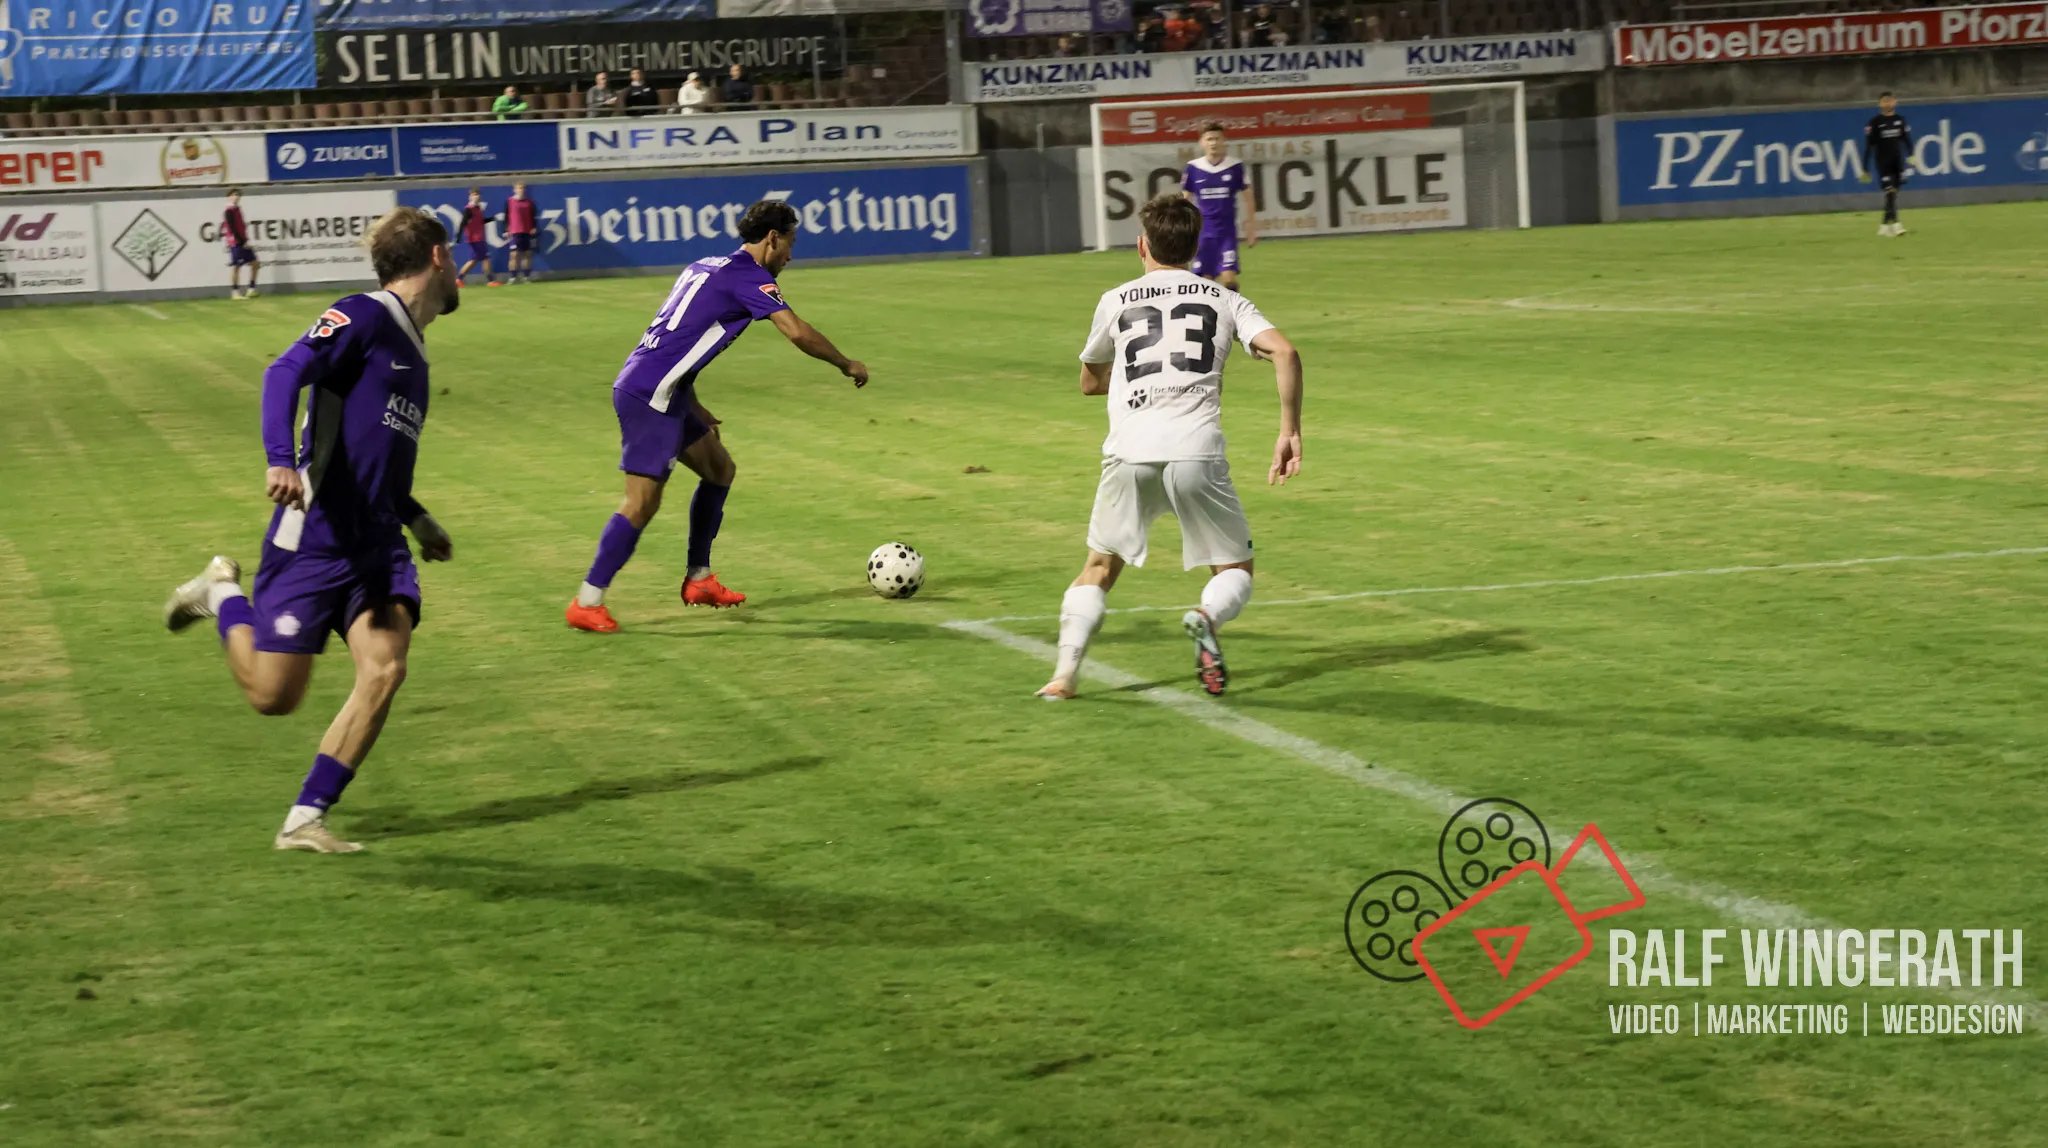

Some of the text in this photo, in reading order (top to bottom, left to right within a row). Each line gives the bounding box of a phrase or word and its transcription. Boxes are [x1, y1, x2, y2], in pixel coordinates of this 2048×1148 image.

[28, 7, 179, 29] RICCO
[212, 4, 300, 25] RUF
[31, 41, 300, 60] PRÄZISIOSSCLEIFERE
[1405, 38, 1575, 65] KUNZMANN
[1631, 20, 1925, 62] Möbelzentrum
[336, 32, 827, 83] SELLIN UNTERNEHMENSGRUPPE
[1194, 49, 1364, 76] KUNZMANN
[980, 60, 1152, 86] KUNZMANN
[567, 125, 740, 151] INFRA
[759, 118, 881, 143] Plan
[312, 144, 388, 163] ZURICH
[1177, 141, 1315, 165] MTHIAS
[1648, 119, 1987, 190] PZ-new.de
[0, 150, 104, 185] erer
[1105, 139, 1450, 228] SCICKLE
[762, 186, 957, 241] eitung
[200, 215, 383, 243] GATENARBEI
[1177, 283, 1221, 298] BOYS
[1118, 303, 1218, 383] 23
